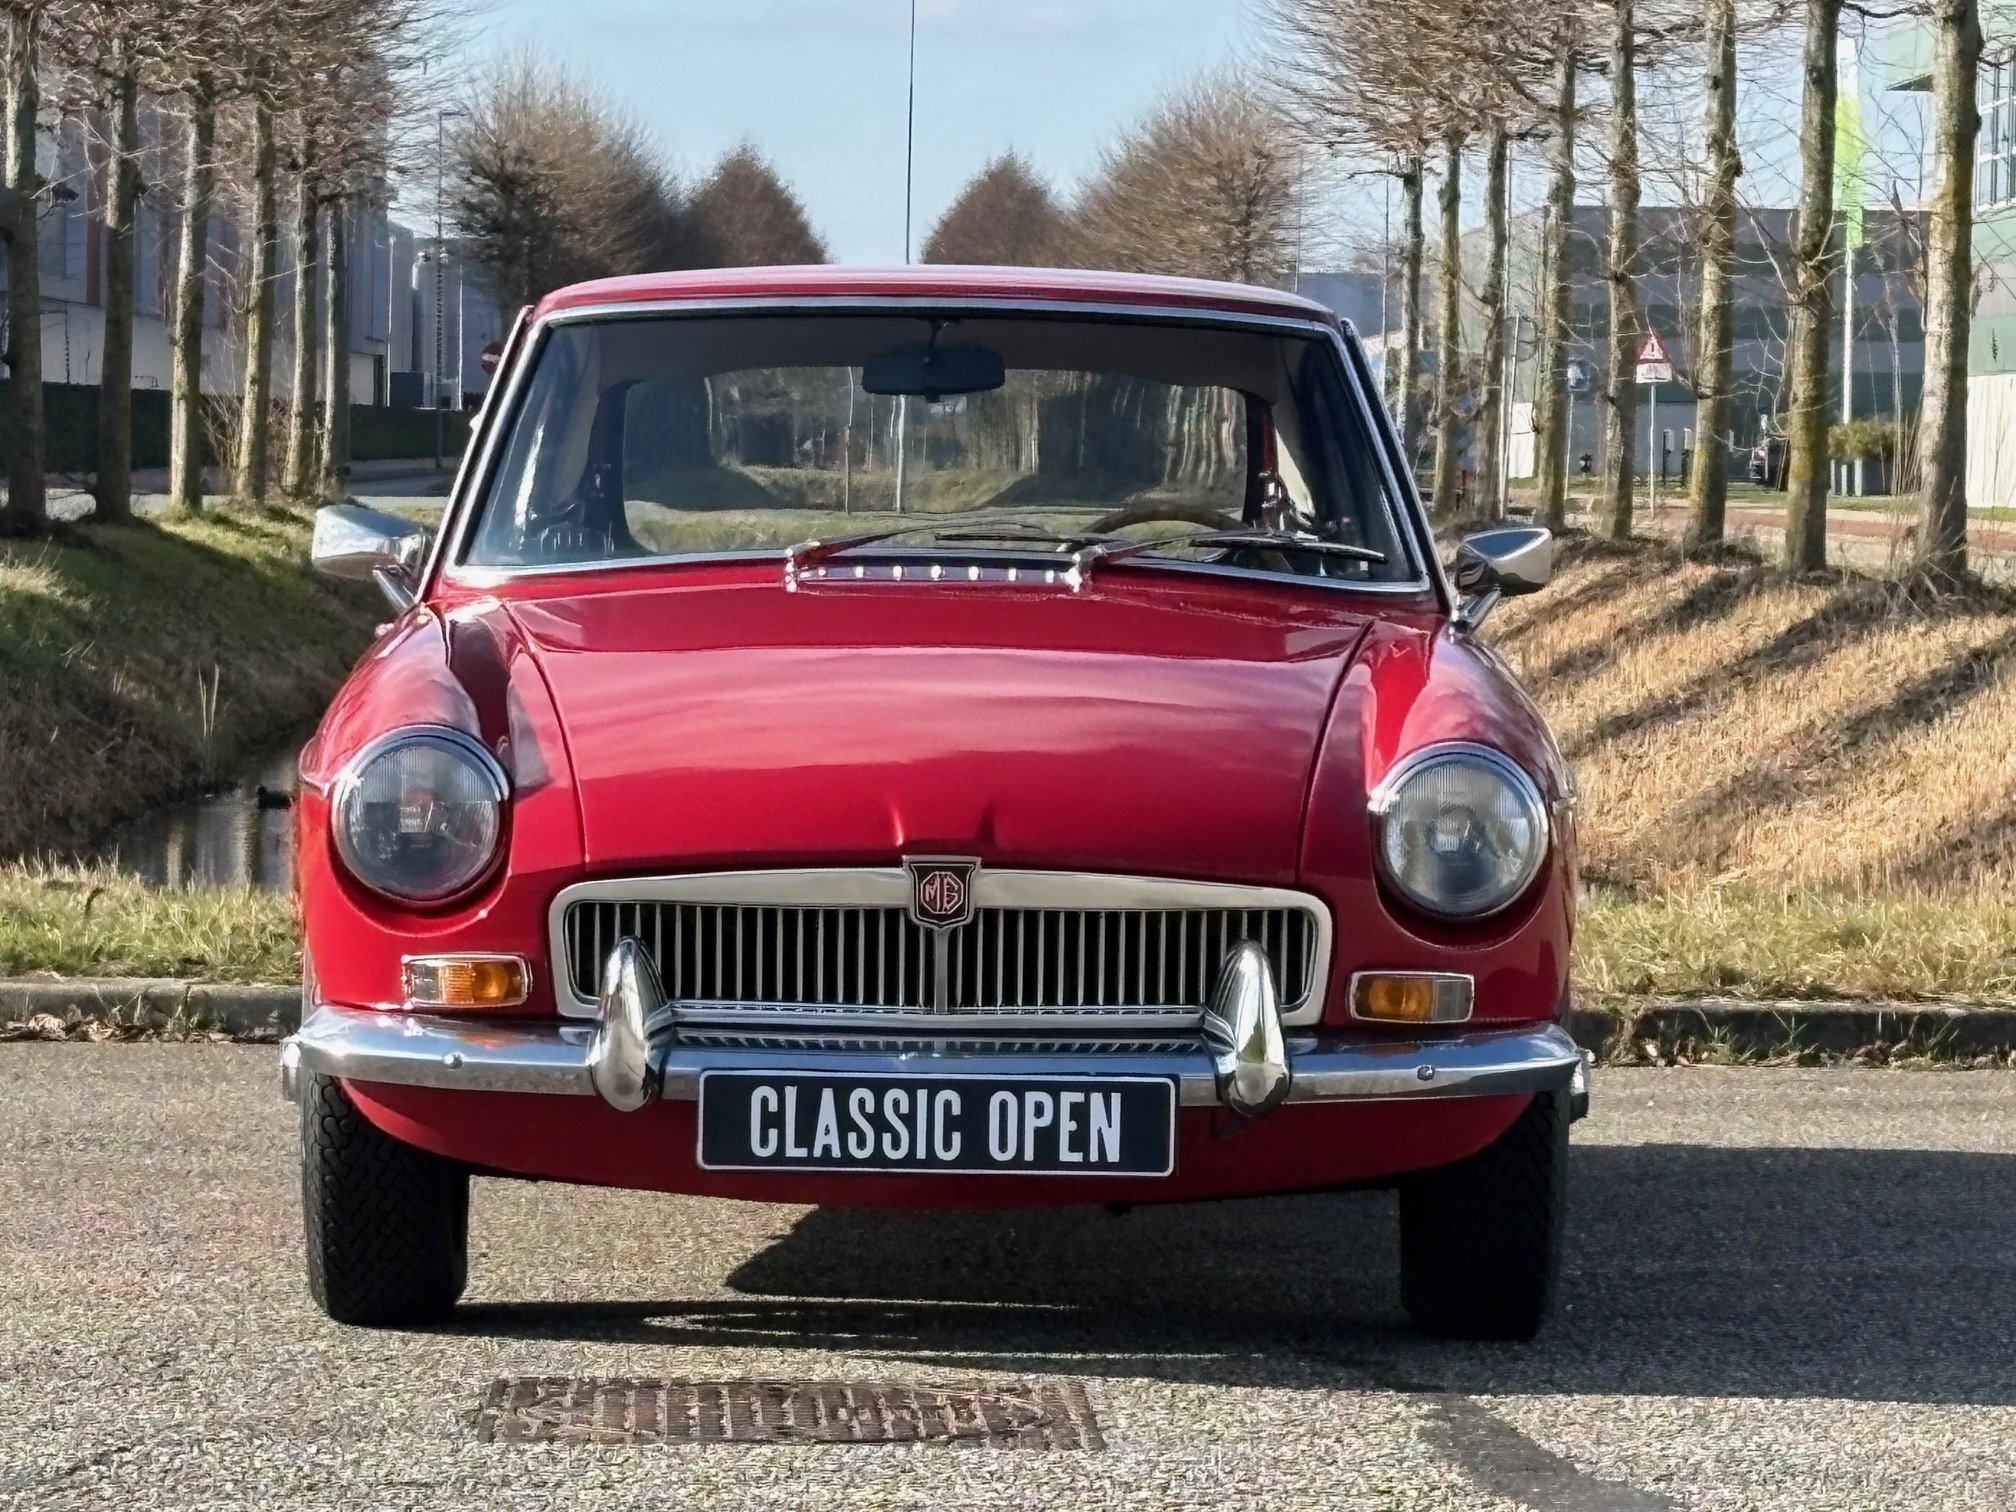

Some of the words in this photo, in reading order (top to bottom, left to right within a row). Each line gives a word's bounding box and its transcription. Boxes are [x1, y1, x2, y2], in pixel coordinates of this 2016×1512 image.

[925, 874, 959, 912] MG
[750, 1085, 962, 1161] CLASSIC
[988, 1090, 1122, 1163] OPEN
